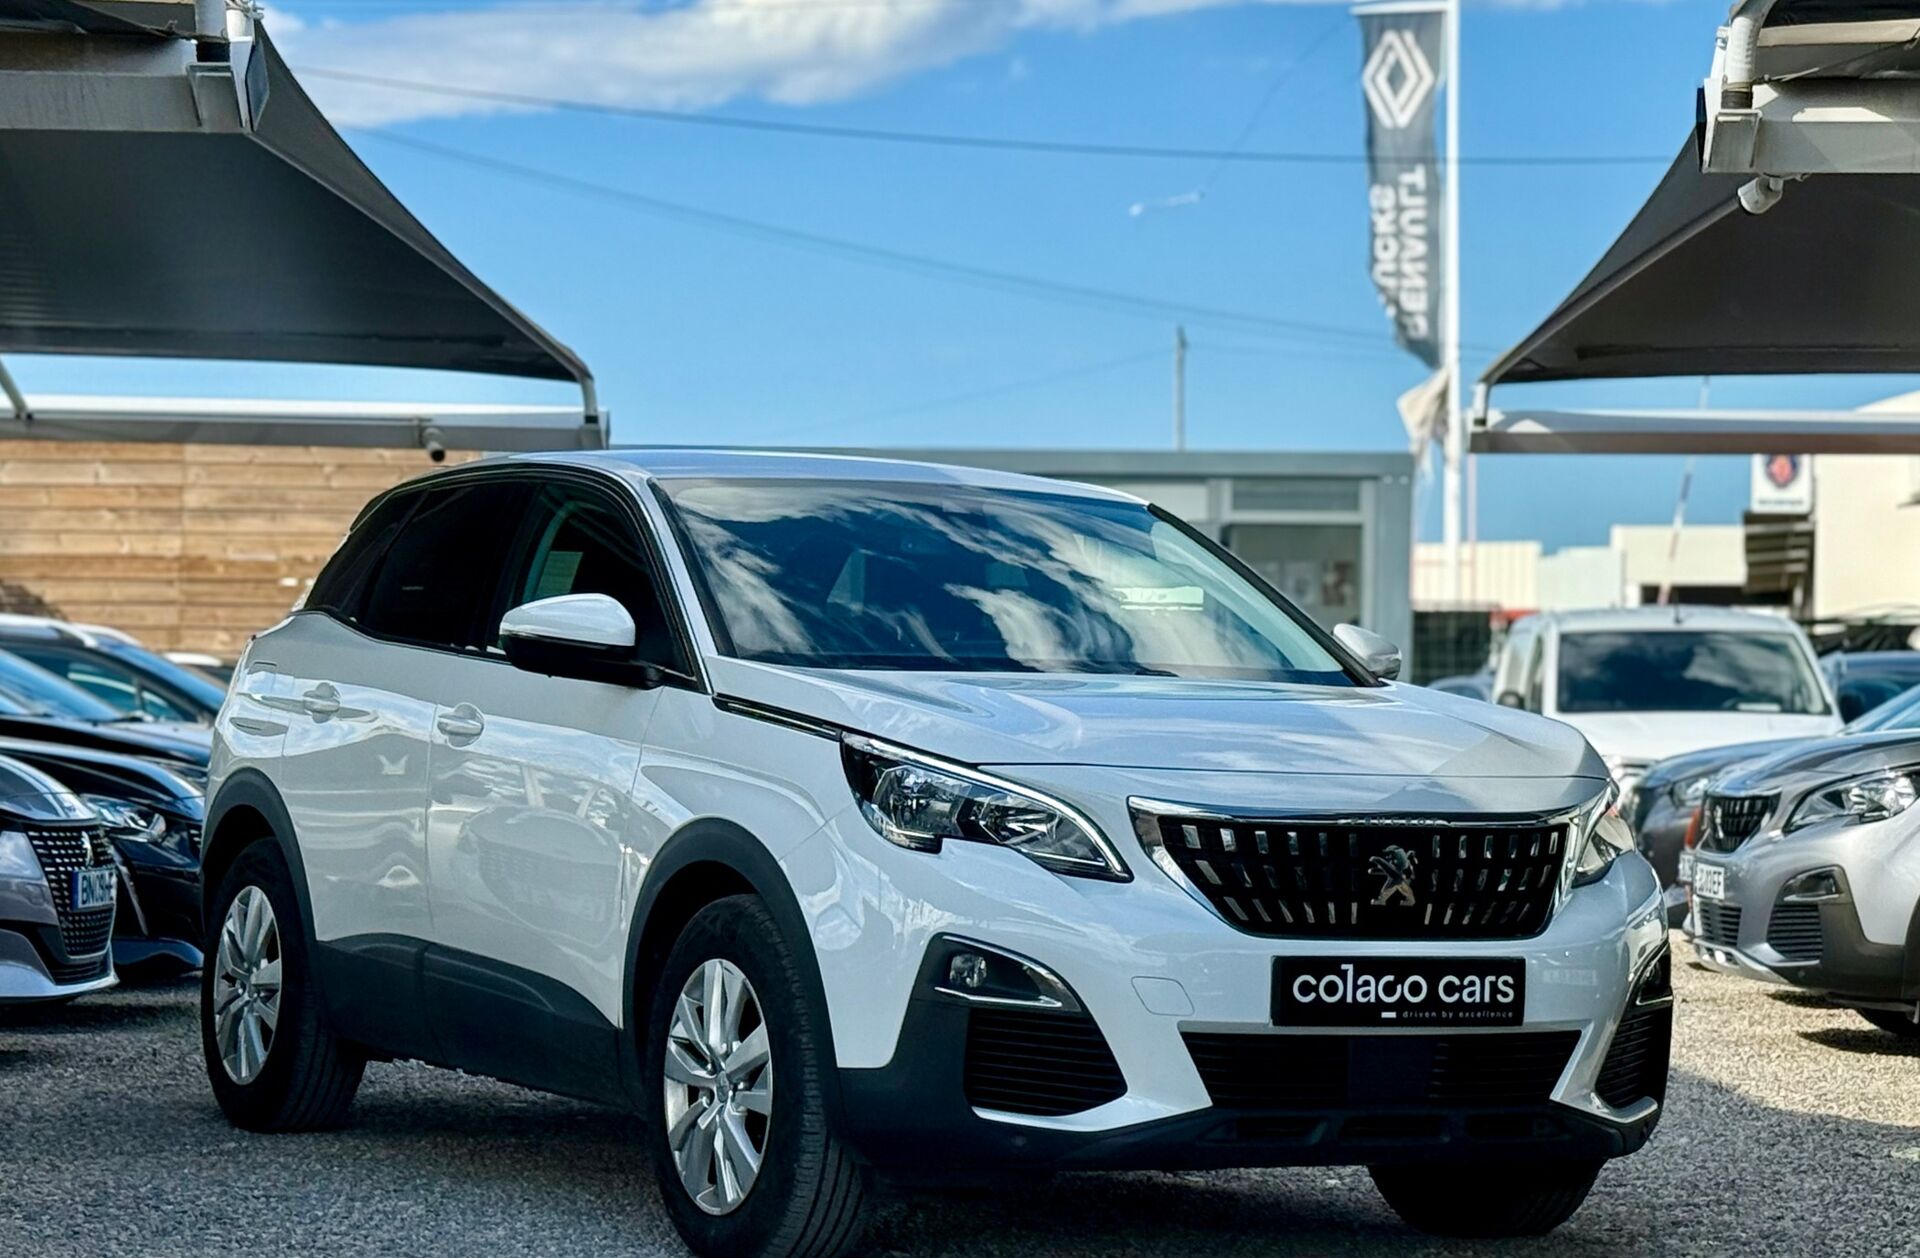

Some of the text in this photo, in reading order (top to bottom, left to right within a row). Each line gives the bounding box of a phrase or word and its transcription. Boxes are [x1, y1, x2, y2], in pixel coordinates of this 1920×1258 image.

[1292, 963, 1515, 1003] colaco cars
[1441, 1011, 1454, 1019] by
